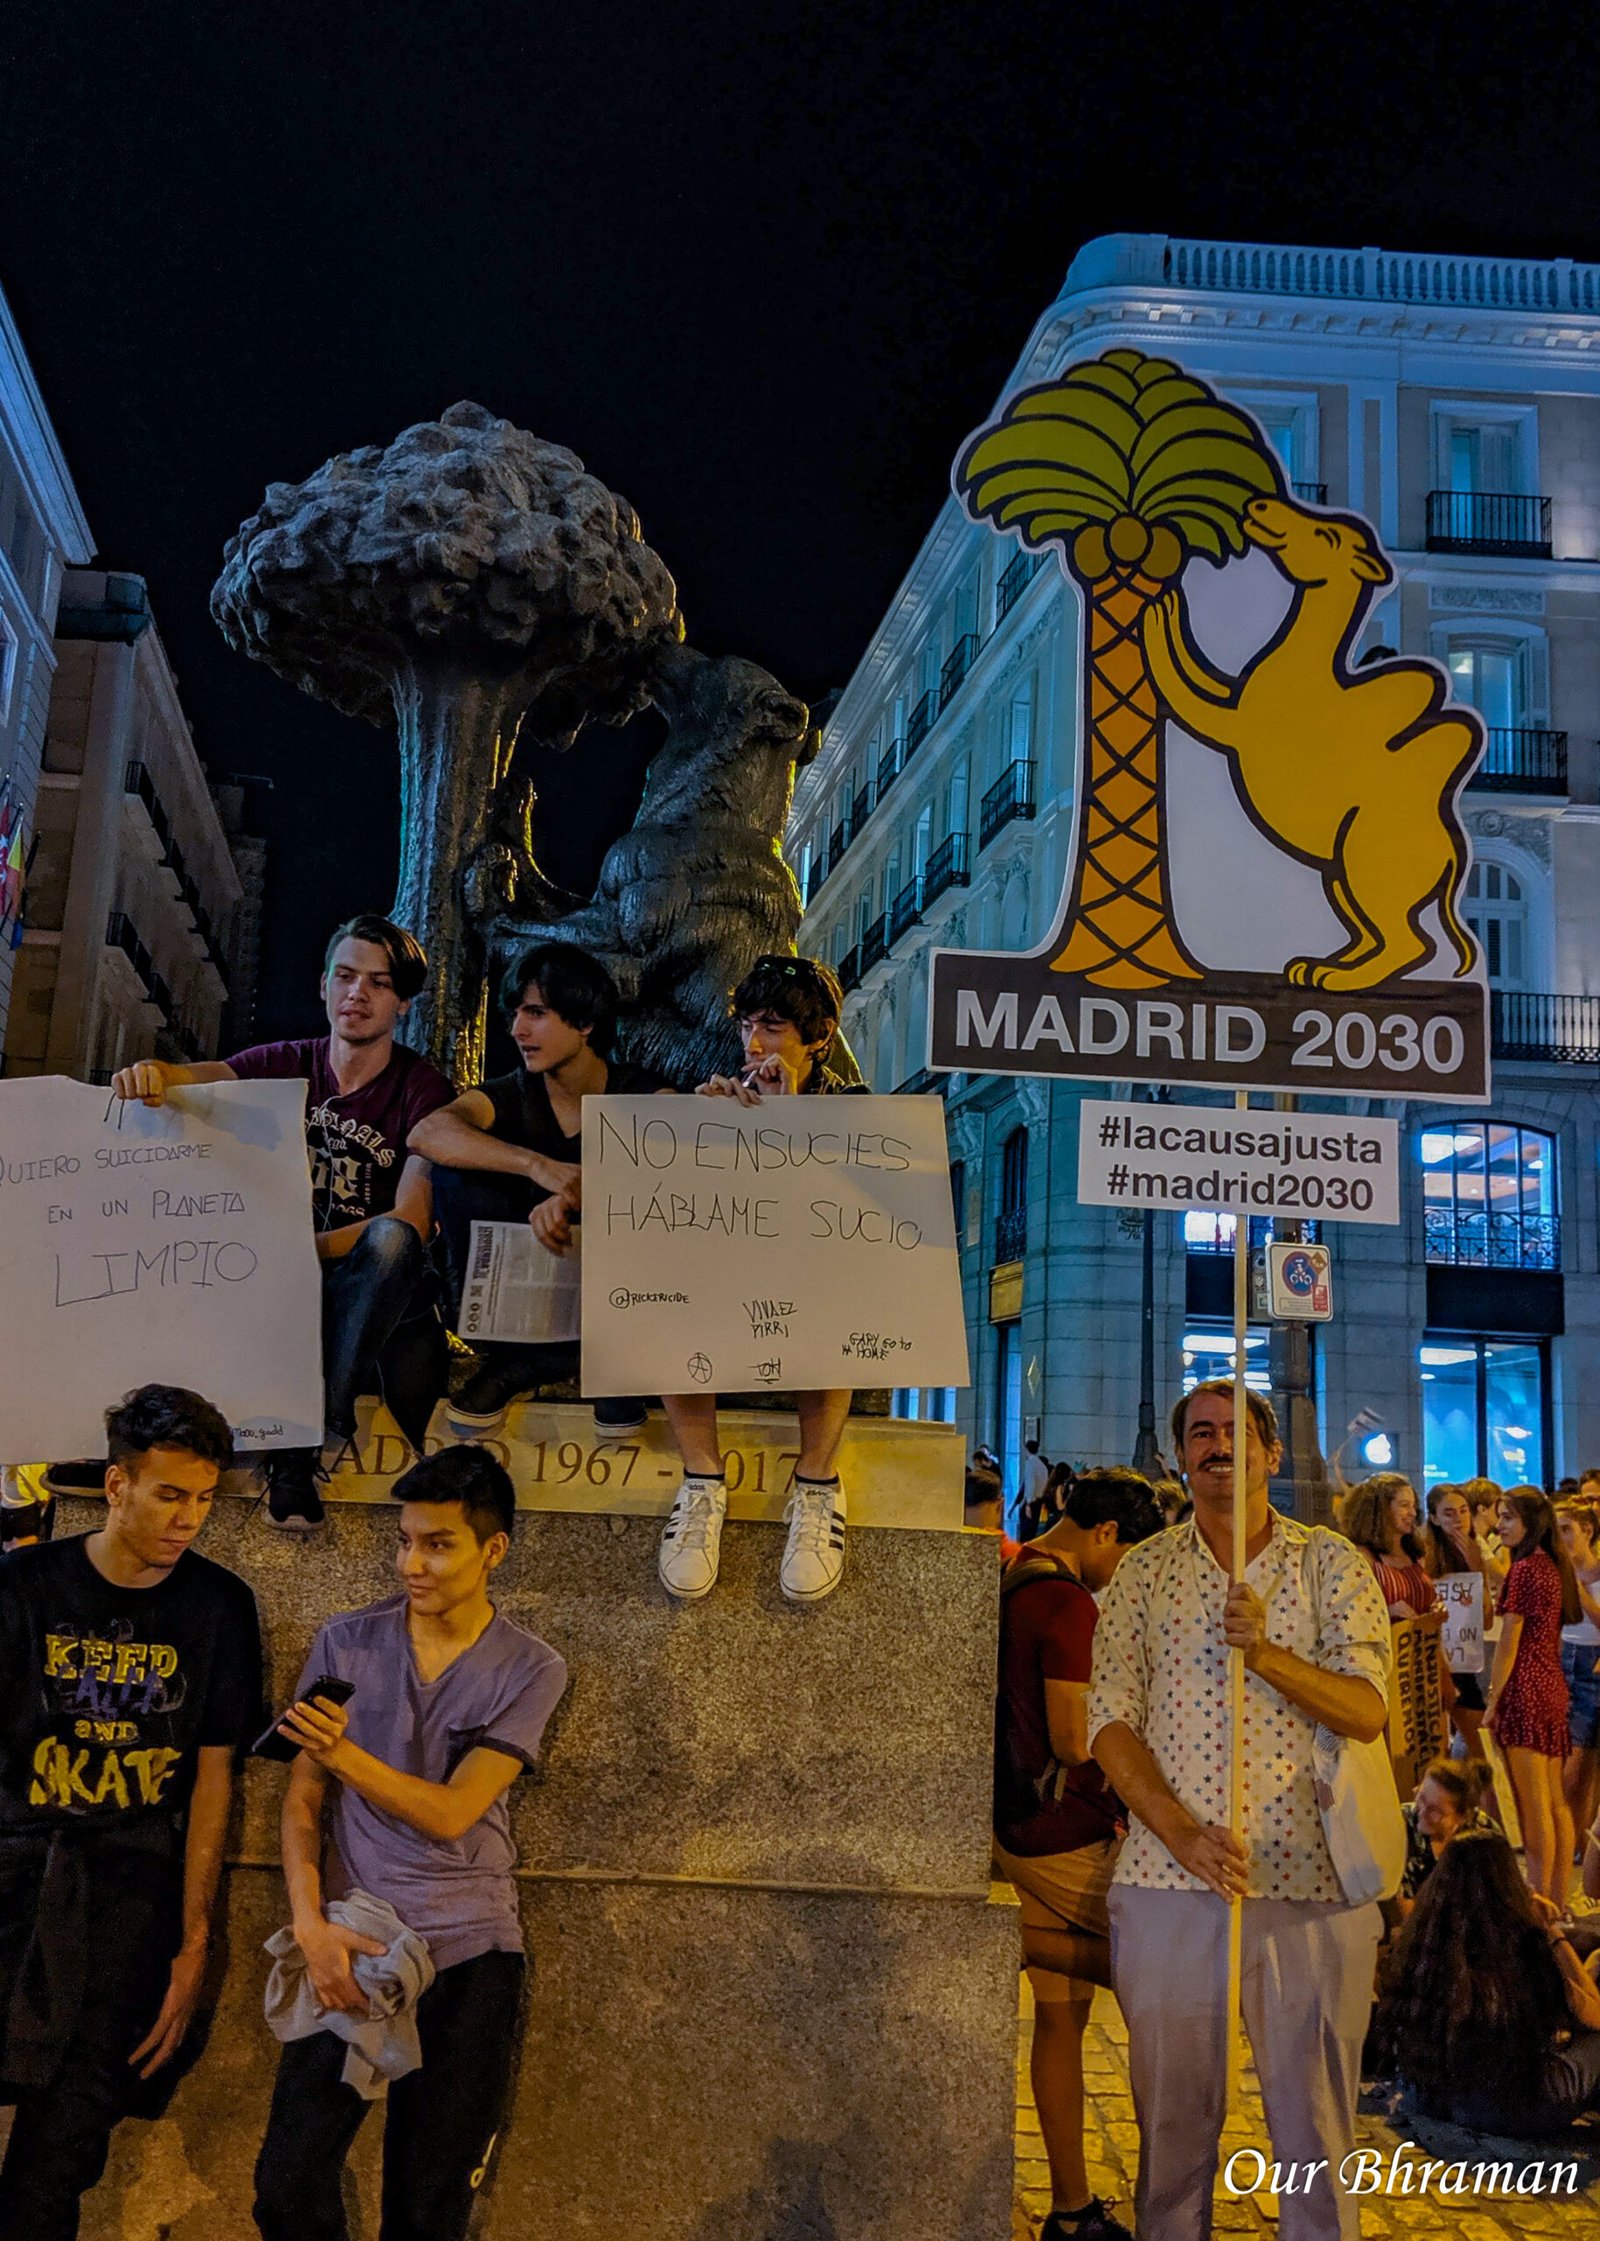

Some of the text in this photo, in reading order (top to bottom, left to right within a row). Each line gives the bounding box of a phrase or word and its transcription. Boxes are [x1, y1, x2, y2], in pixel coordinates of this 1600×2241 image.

[955, 989, 1465, 1074] MADRID 2030
[0, 1143, 212, 1186] UIERO SUICIDARME
[599, 1111, 912, 1172] NO ENSUCIES
[1099, 1115, 1382, 1166] #lacausajusta
[48, 1189, 245, 1224] EN UN PLANETA
[1107, 1163, 1373, 1212] #madrid2030
[607, 1181, 922, 1251] HÁBLAME SUCIO
[56, 1241, 258, 1307] LIMPIO
[849, 1332, 880, 1347] GARY
[531, 1440, 641, 1488] 1967
[722, 1449, 801, 1494] 017
[44, 1633, 178, 1684] KEEP
[1459, 1627, 1477, 1642] NO
[29, 1735, 182, 1809] SKATE
